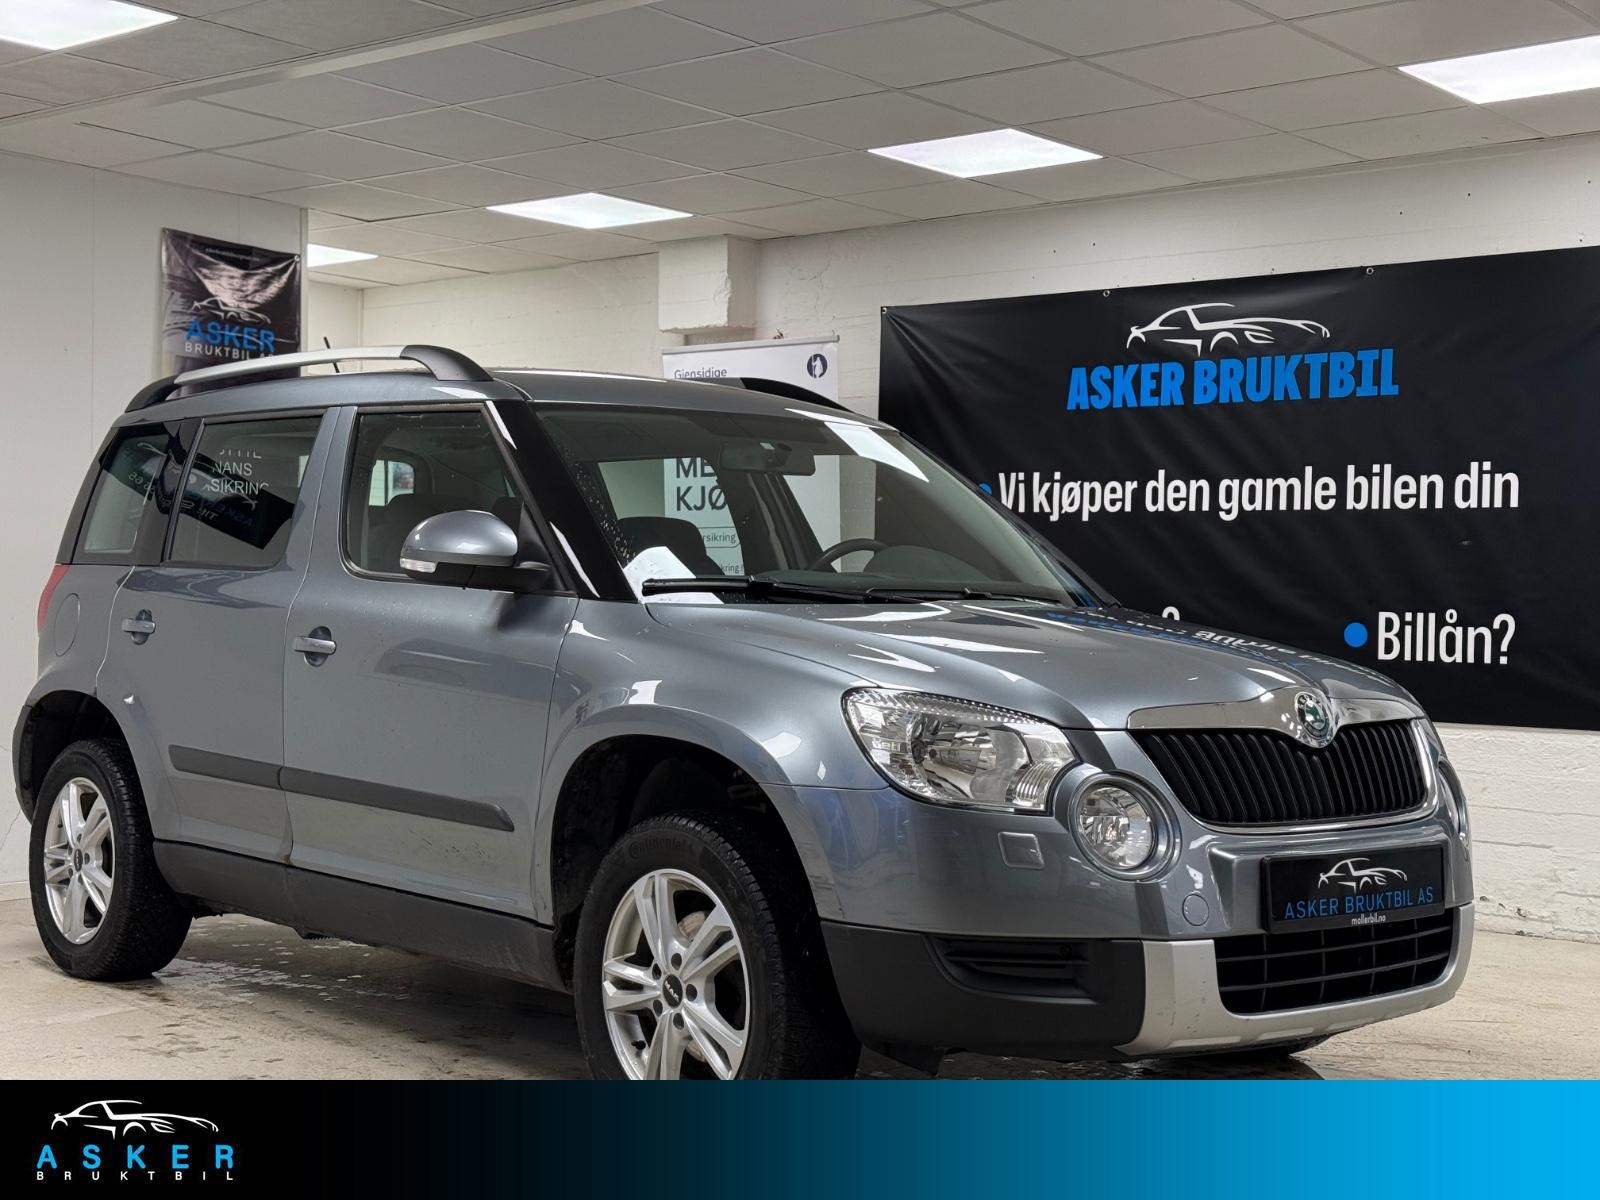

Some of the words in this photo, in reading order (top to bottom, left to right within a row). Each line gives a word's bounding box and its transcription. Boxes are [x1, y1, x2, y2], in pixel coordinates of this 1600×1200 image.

[184, 318, 276, 353] ASKER
[184, 341, 252, 360] BRUKTBIL
[1066, 361, 1185, 411] ASKER
[1192, 347, 1400, 405] BRUKTBIL
[214, 461, 253, 477] NANS
[998, 472, 1026, 513] Vi
[1033, 472, 1138, 522] kjøper
[1145, 469, 1210, 512] den
[1218, 466, 1337, 522] gamle
[1347, 463, 1444, 511] bilen
[1454, 461, 1520, 509] din
[1378, 609, 1516, 665] Billån?
[1284, 899, 1339, 919] ASKER
[1345, 889, 1413, 914] BRUKTBIL
[1418, 886, 1434, 905] AS
